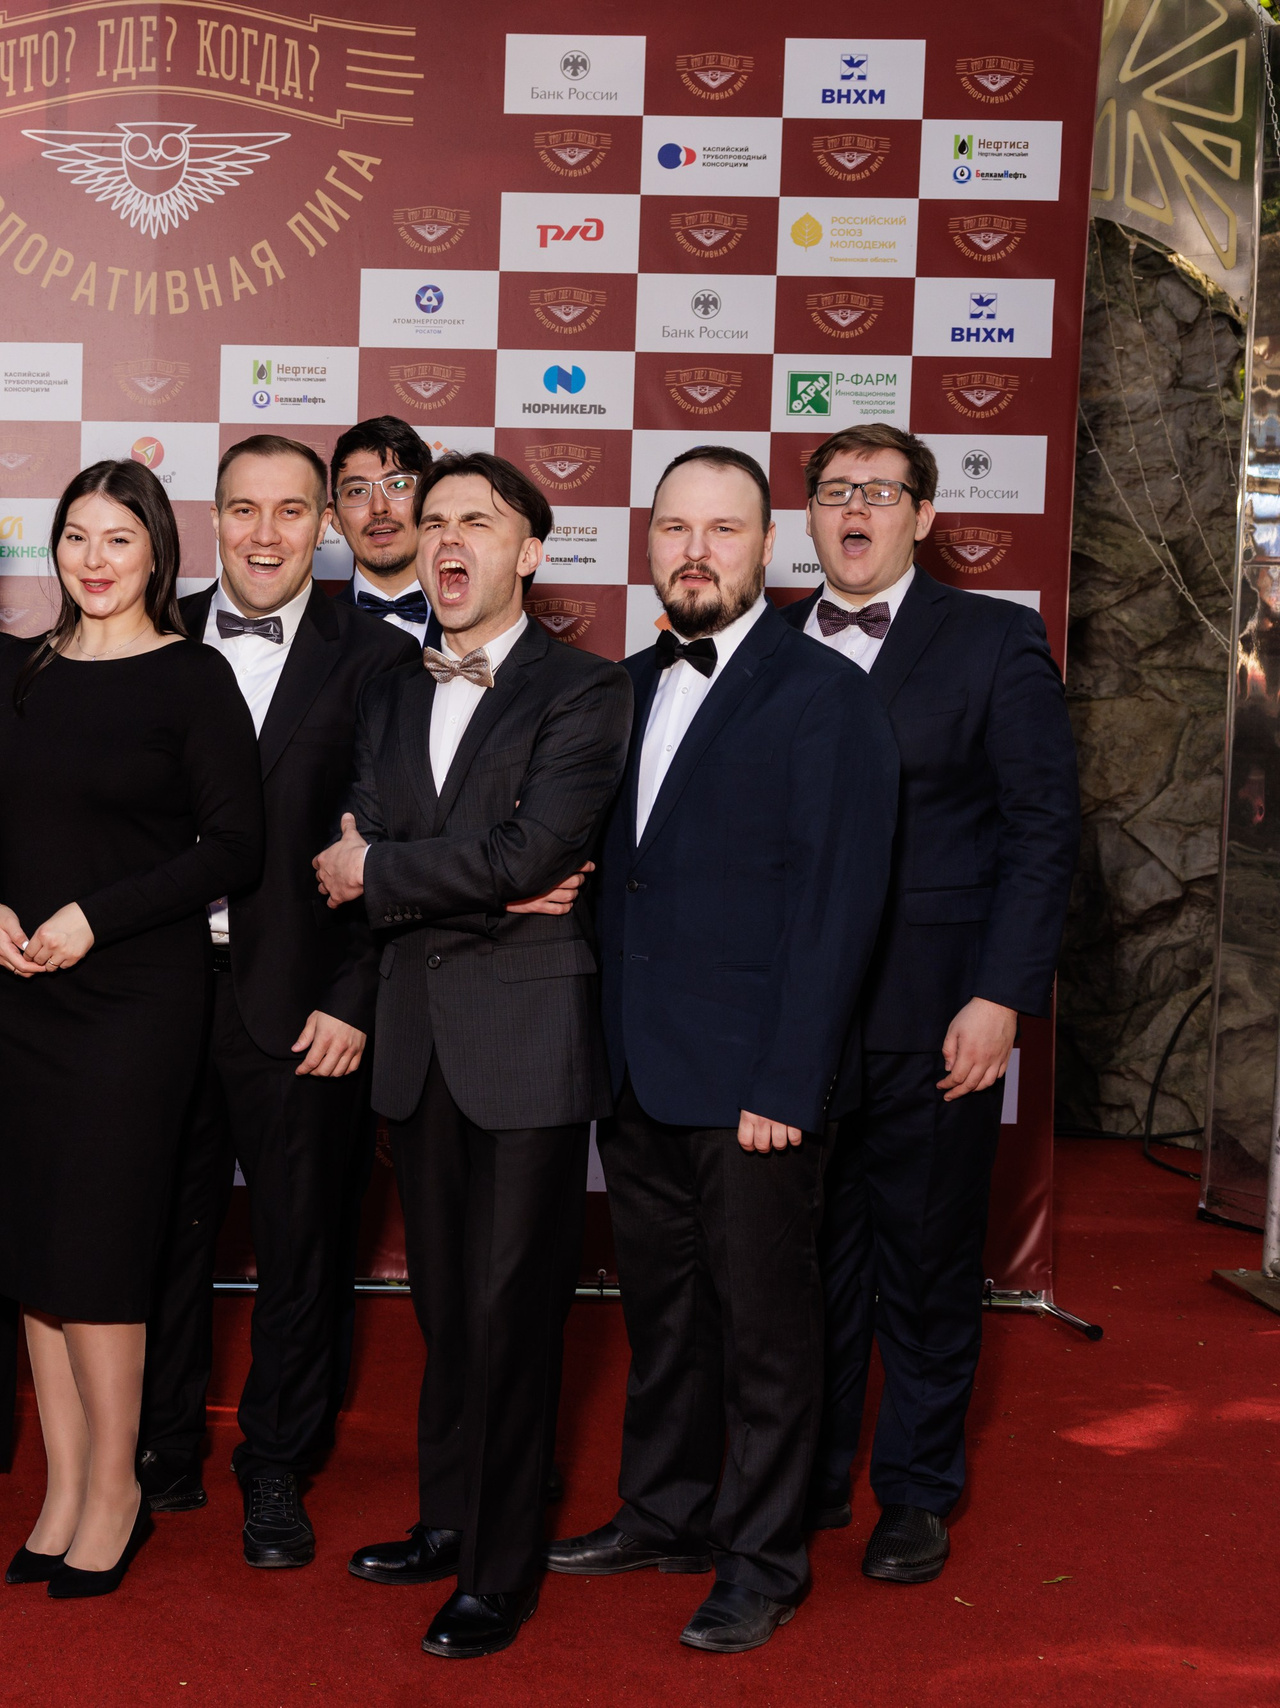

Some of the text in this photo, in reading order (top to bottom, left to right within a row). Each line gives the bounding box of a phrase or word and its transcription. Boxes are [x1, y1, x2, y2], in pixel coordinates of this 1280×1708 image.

[96, 15, 178, 83] ГДЕ?
[196, 18, 320, 102] КОГДА?
[530, 87, 618, 101] Банк России
[680, 73, 734, 100] КОРПОРАТИВНАЯ
[960, 76, 1014, 103] КОРПОРАТИВНАЯ
[821, 88, 885, 105] ВНХМ
[978, 138, 1029, 151] Нефтиса
[538, 150, 592, 177] КОРПОРАТИВНАЯ
[702, 153, 767, 161] ТРУБОПРОВОДНЫЙ
[816, 154, 870, 181] КОРПОРАТИВНАЯ
[975, 169, 1027, 180] БелкамНефть
[286, 148, 382, 258] ЛИГА
[831, 214, 907, 226] РОССИЙСКИЙ
[830, 228, 863, 237] СОЮЗ
[398, 227, 451, 254] КОРПОРАТИВНАЯ
[674, 231, 728, 258] КОРПОРАТИВНАЯ
[830, 240, 896, 250] МОЛОДЕЖИ
[952, 235, 1006, 262] КОРПОРАТИВНАЯ
[392, 317, 465, 326] АТОМЭНЕРГОПРОЕКТ
[534, 307, 587, 334] КОРПОРАТИВНАЯ
[810, 312, 864, 339] КОРПОРАТИВНАЯ
[662, 326, 748, 340] Банк России
[951, 327, 1014, 343] ВНХМ
[276, 363, 327, 376] Нефтиса
[4, 378, 68, 386] ТРУБОПРОВОДНЫЙ
[835, 373, 897, 386] Р-ФАРМ
[274, 394, 326, 405] БелкамНефть
[394, 383, 447, 410] КОРПОРАТИВНАЯ
[835, 389, 896, 398] Инновационные
[522, 403, 606, 415] НОРНИКЕЛЬ
[670, 388, 723, 415] КОРПОРАТИВНАЯ
[853, 399, 896, 407] технологии
[946, 392, 999, 419] КОРПОРАТИВНАЯ
[528, 463, 582, 490] КОРПОРАТИВНАЯ
[970, 486, 1018, 499] России
[546, 554, 596, 564] БелкамНефть
[938, 547, 992, 574] КОРПОРАТИВНАЯ
